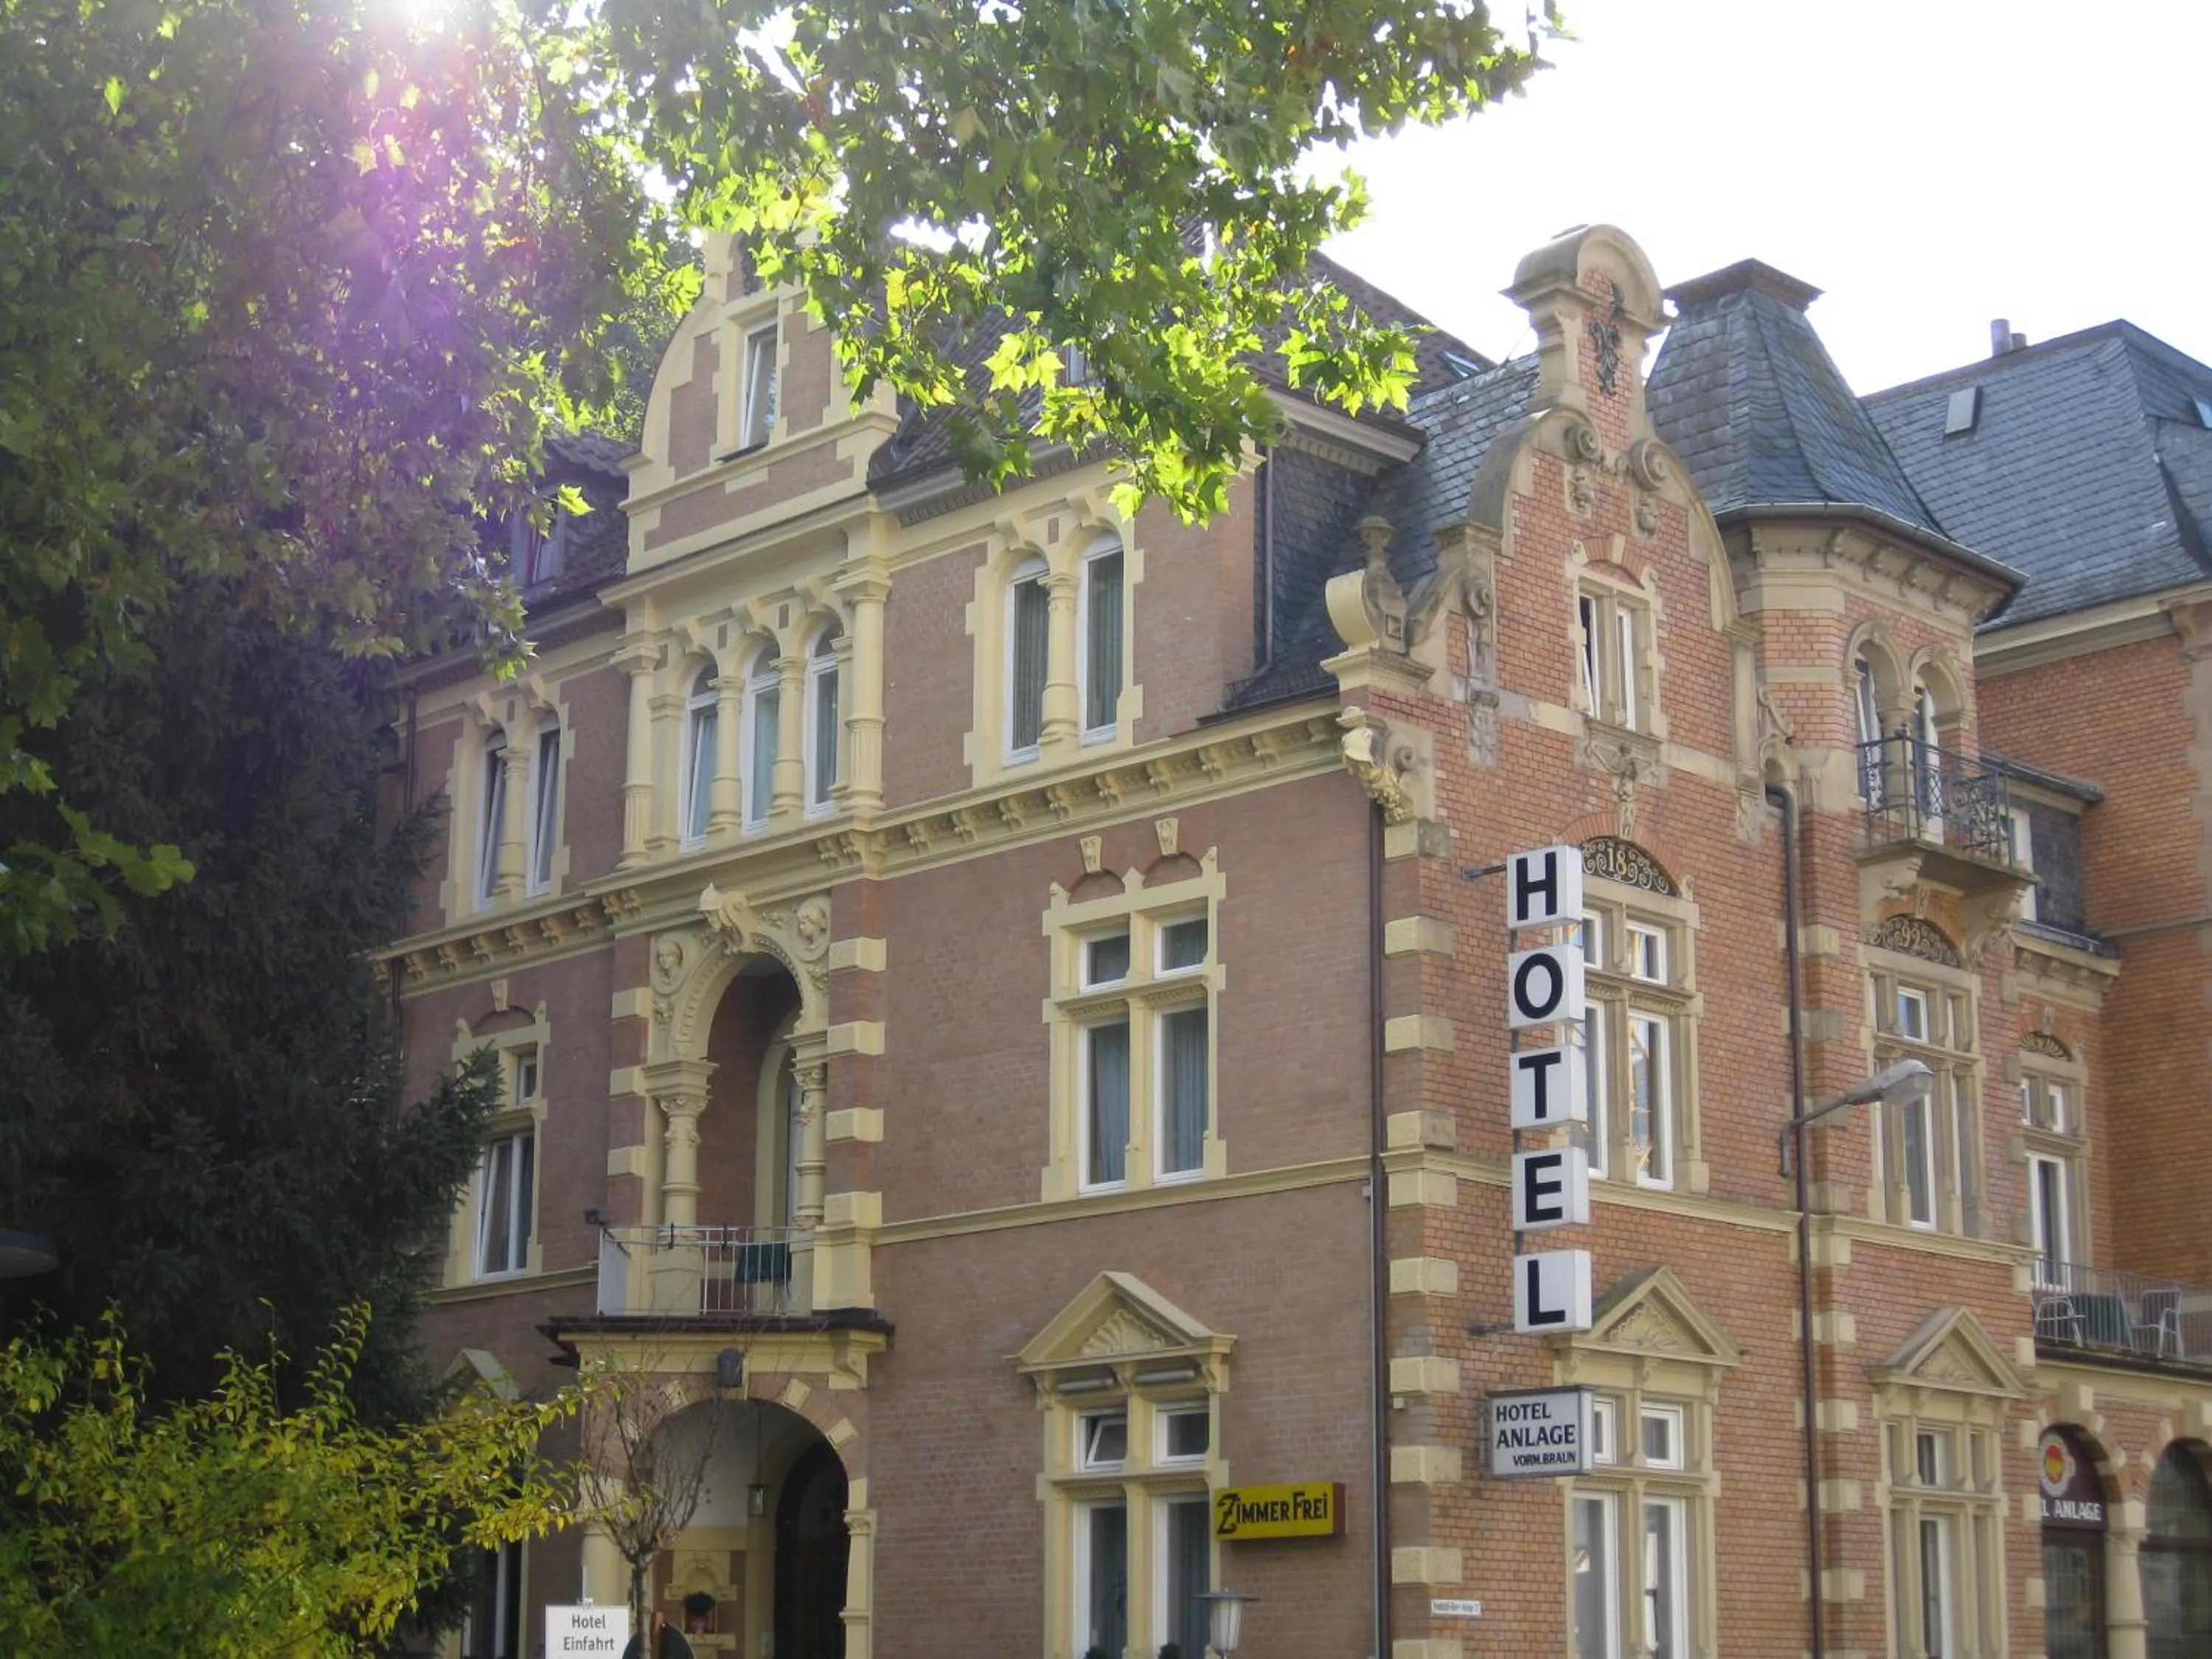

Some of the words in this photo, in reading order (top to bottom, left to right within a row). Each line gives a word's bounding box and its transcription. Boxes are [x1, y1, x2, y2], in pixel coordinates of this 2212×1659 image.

[1514, 852, 1566, 1326] HOTEL
[1496, 1402, 1551, 1422] HOTEL
[1496, 1425, 1576, 1449] ANLAGE
[2054, 1499, 2101, 1520] ANLAGE
[571, 1614, 605, 1629] Hotel
[563, 1636, 614, 1651] Einfahrt
